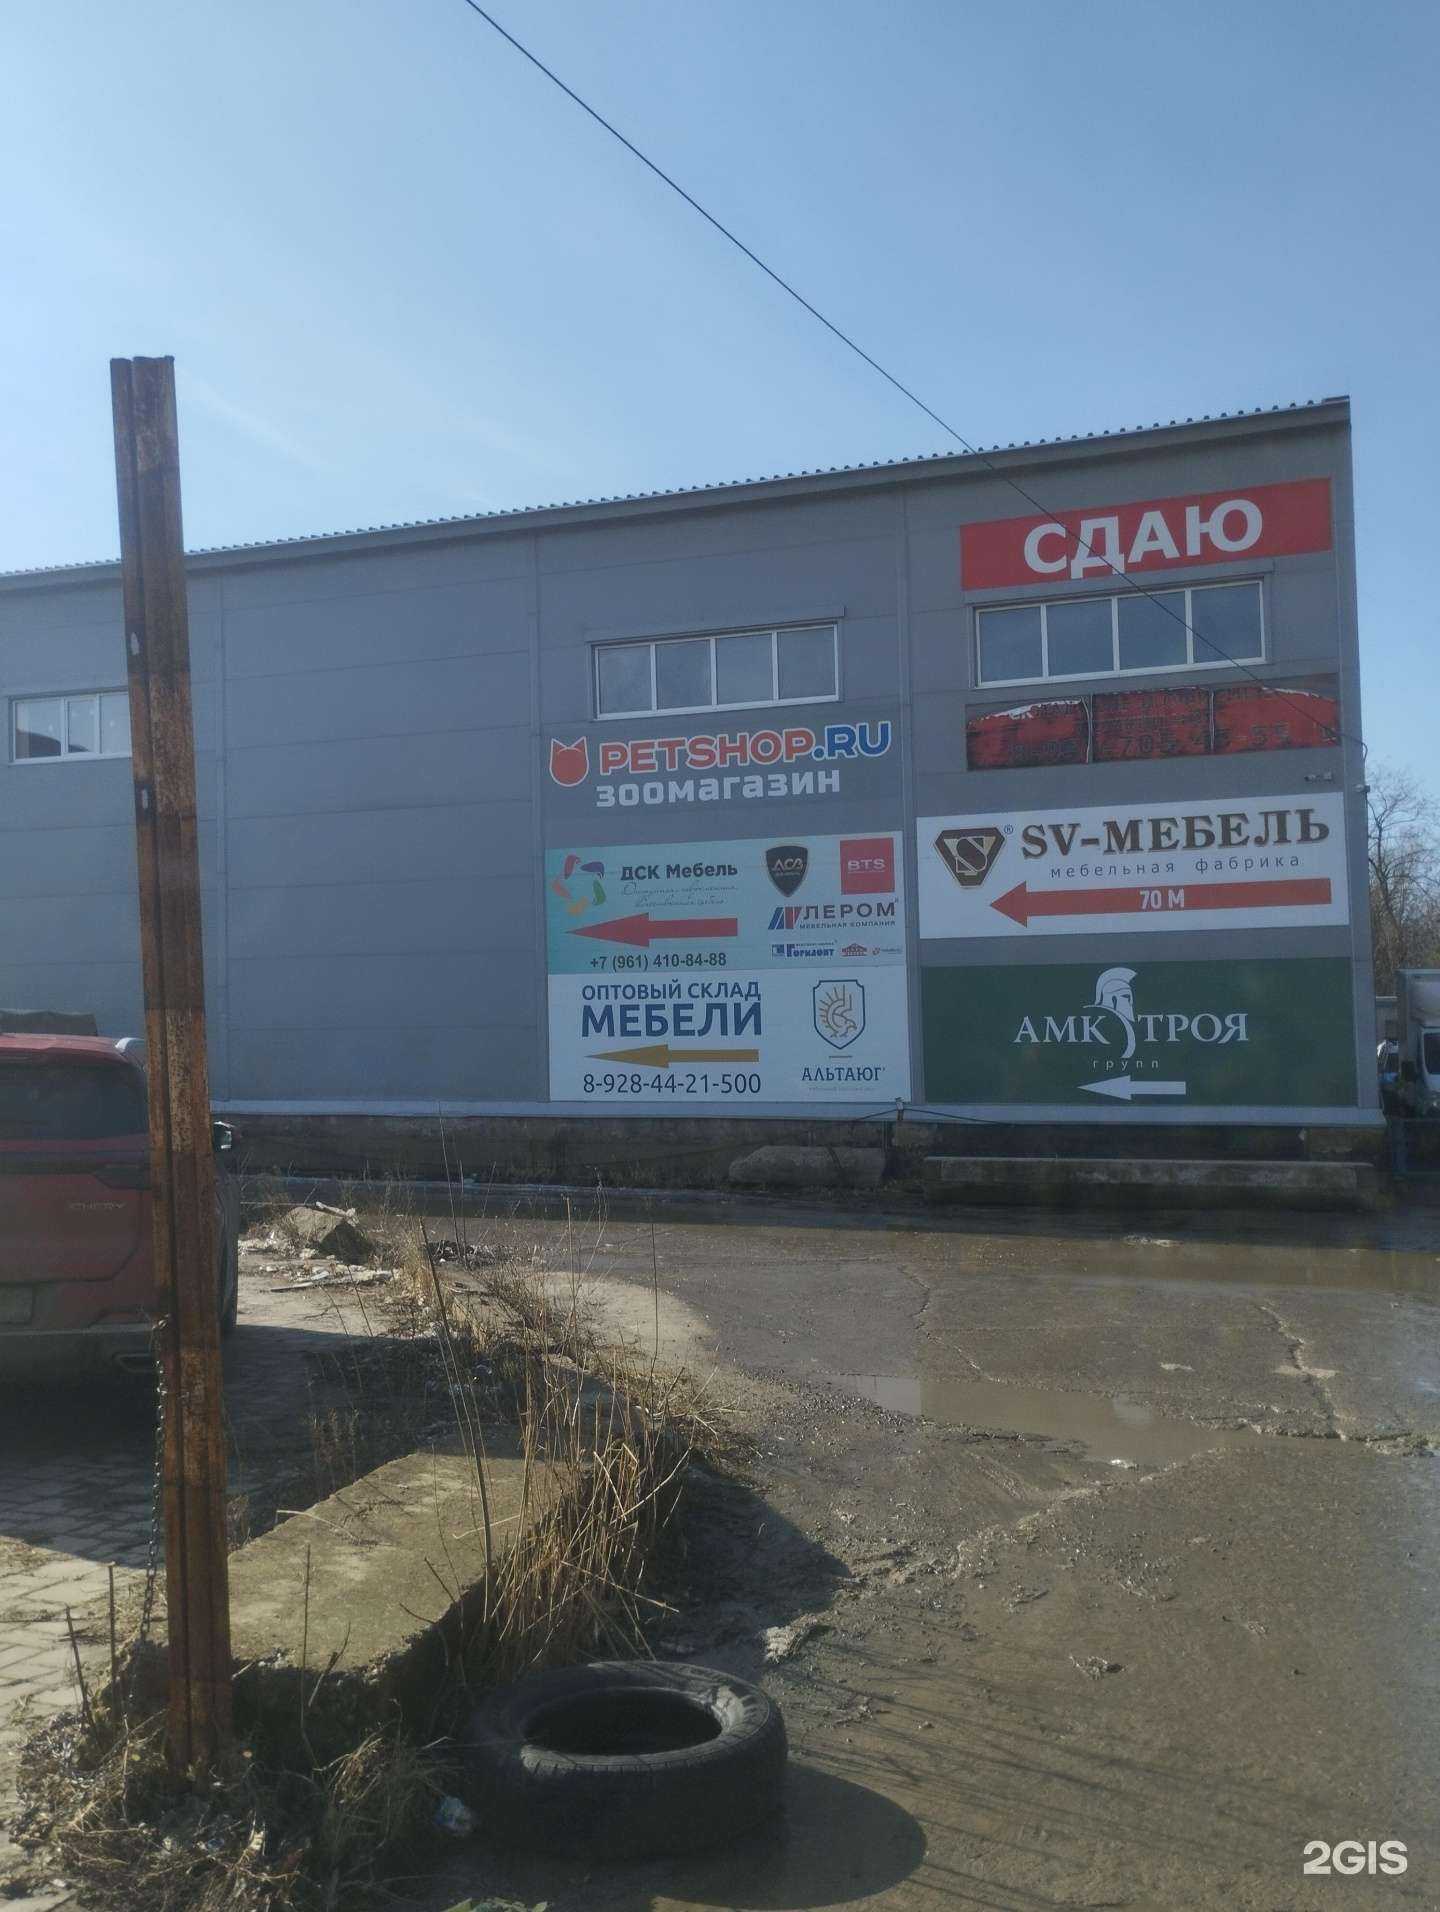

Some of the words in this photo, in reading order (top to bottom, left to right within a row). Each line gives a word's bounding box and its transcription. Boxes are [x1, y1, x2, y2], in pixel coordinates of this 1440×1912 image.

[1023, 499, 1263, 579] СДАЮ
[600, 721, 891, 775] PETSHOP.RU
[596, 769, 840, 807] зоомагазин
[1022, 809, 1331, 860] SV-МЕБЕЛЬ
[621, 865, 660, 881] ДСК
[666, 863, 738, 880] Мебель
[847, 858, 886, 871] BTS
[1050, 862, 1175, 879] мебельная
[1195, 856, 1300, 875] фабрика
[803, 902, 896, 920] ЛЕРОМ
[1139, 890, 1162, 909] 70
[589, 955, 608, 969] +7
[612, 954, 649, 972] (961)
[653, 952, 727, 968] 410-84-88
[581, 979, 682, 1001] ОПТОВЫЙ
[687, 981, 762, 1001] СКЛАД
[581, 1002, 763, 1038] МЕБЕЛИ
[1013, 1014, 1111, 1045] АМК
[1137, 1013, 1249, 1044] ТРОЯ
[1093, 1058, 1160, 1071] групп
[583, 1072, 762, 1095] 8-928-44-21-500
